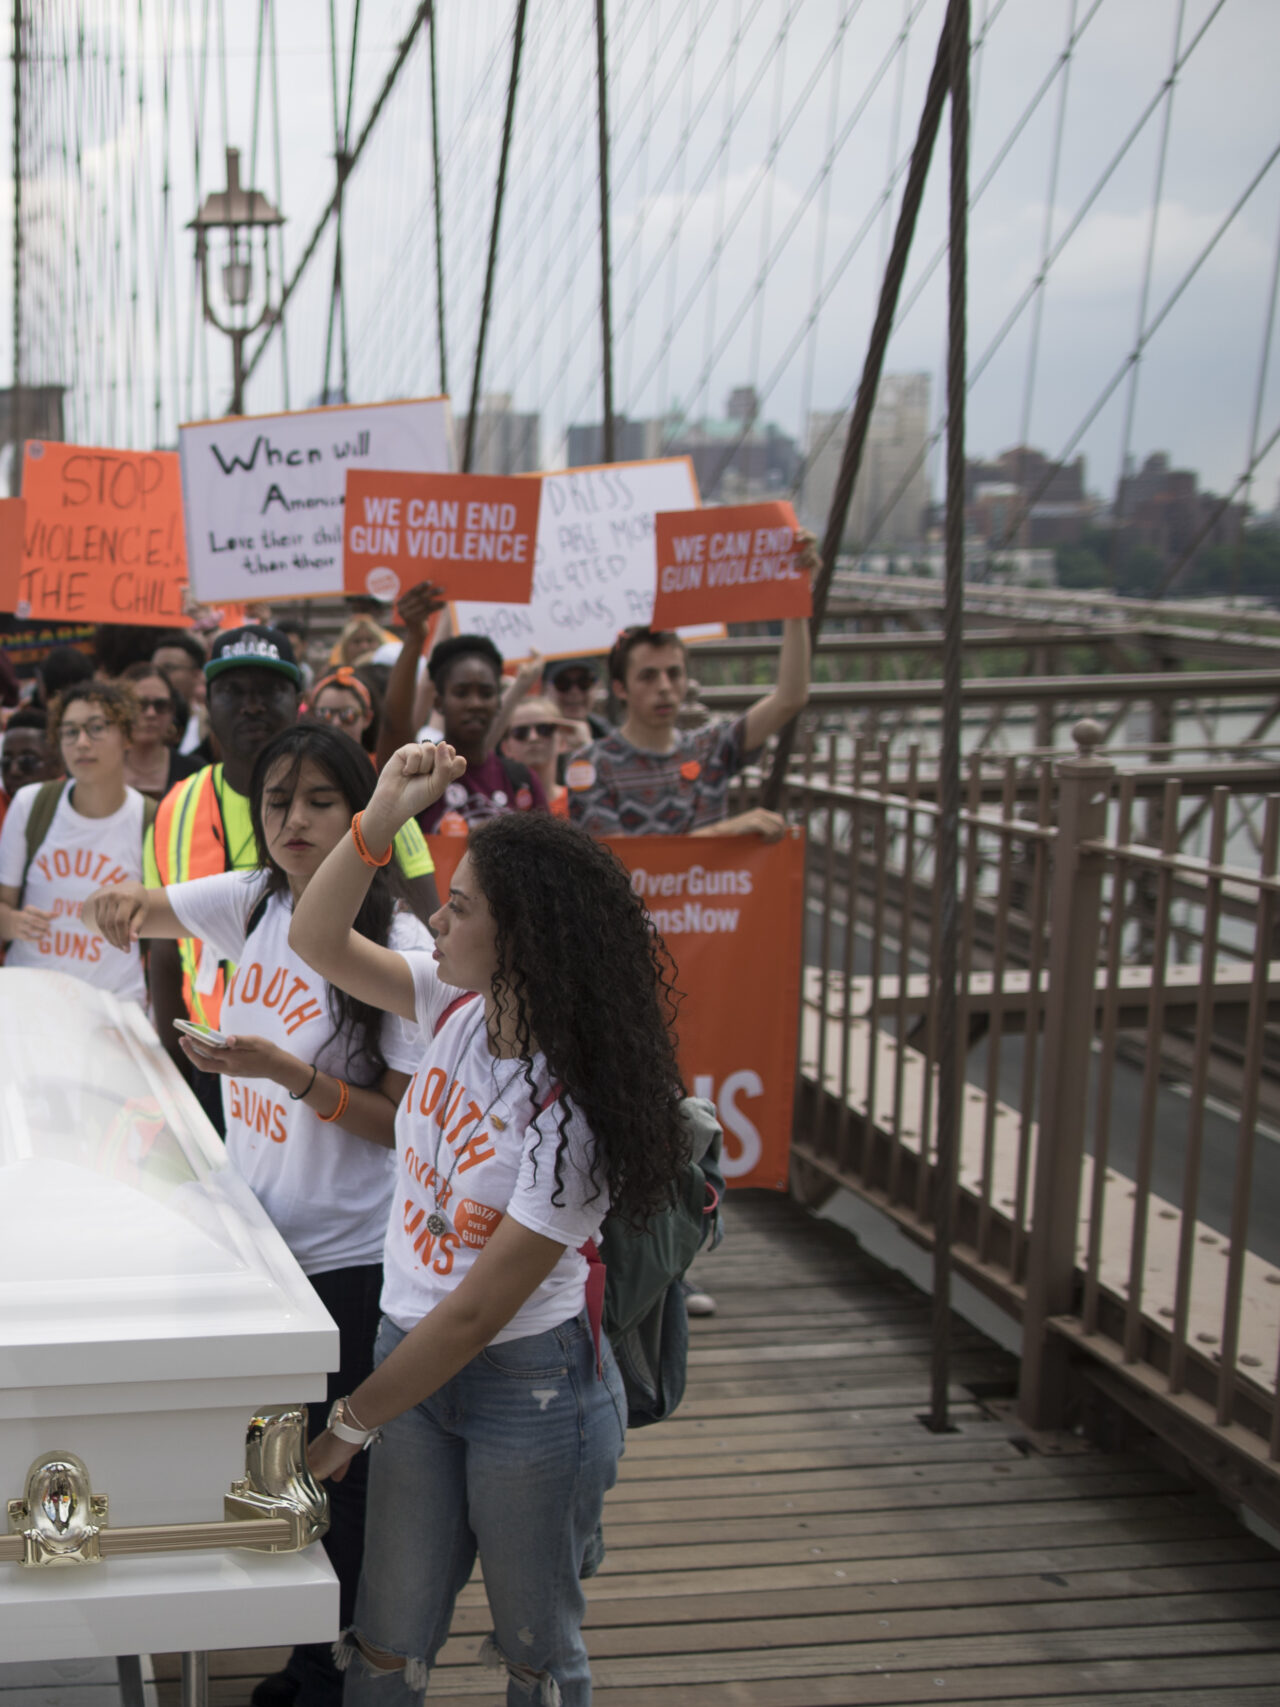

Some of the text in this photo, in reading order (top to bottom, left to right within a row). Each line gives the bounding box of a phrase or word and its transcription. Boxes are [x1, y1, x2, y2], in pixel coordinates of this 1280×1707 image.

[209, 429, 371, 476] When will
[61, 454, 164, 512] STOP
[363, 496, 518, 533] WE CAN END
[207, 530, 256, 554] Love
[313, 524, 343, 545] chil
[349, 525, 401, 557] GUN
[405, 528, 529, 564] VIOLENCE
[671, 524, 794, 564] WE CAN END
[20, 566, 91, 613] THE
[660, 552, 803, 594] GUN VIOLENCE
[36, 847, 129, 886] YOUTH
[630, 863, 753, 897] OverGuns
[51, 897, 84, 919] OVE
[37, 929, 106, 963] GUNS
[227, 960, 324, 1036] YOUTH
[228, 1078, 288, 1145] GUNS
[463, 1200, 497, 1222] YOUTH
[403, 1198, 462, 1277] UNS
